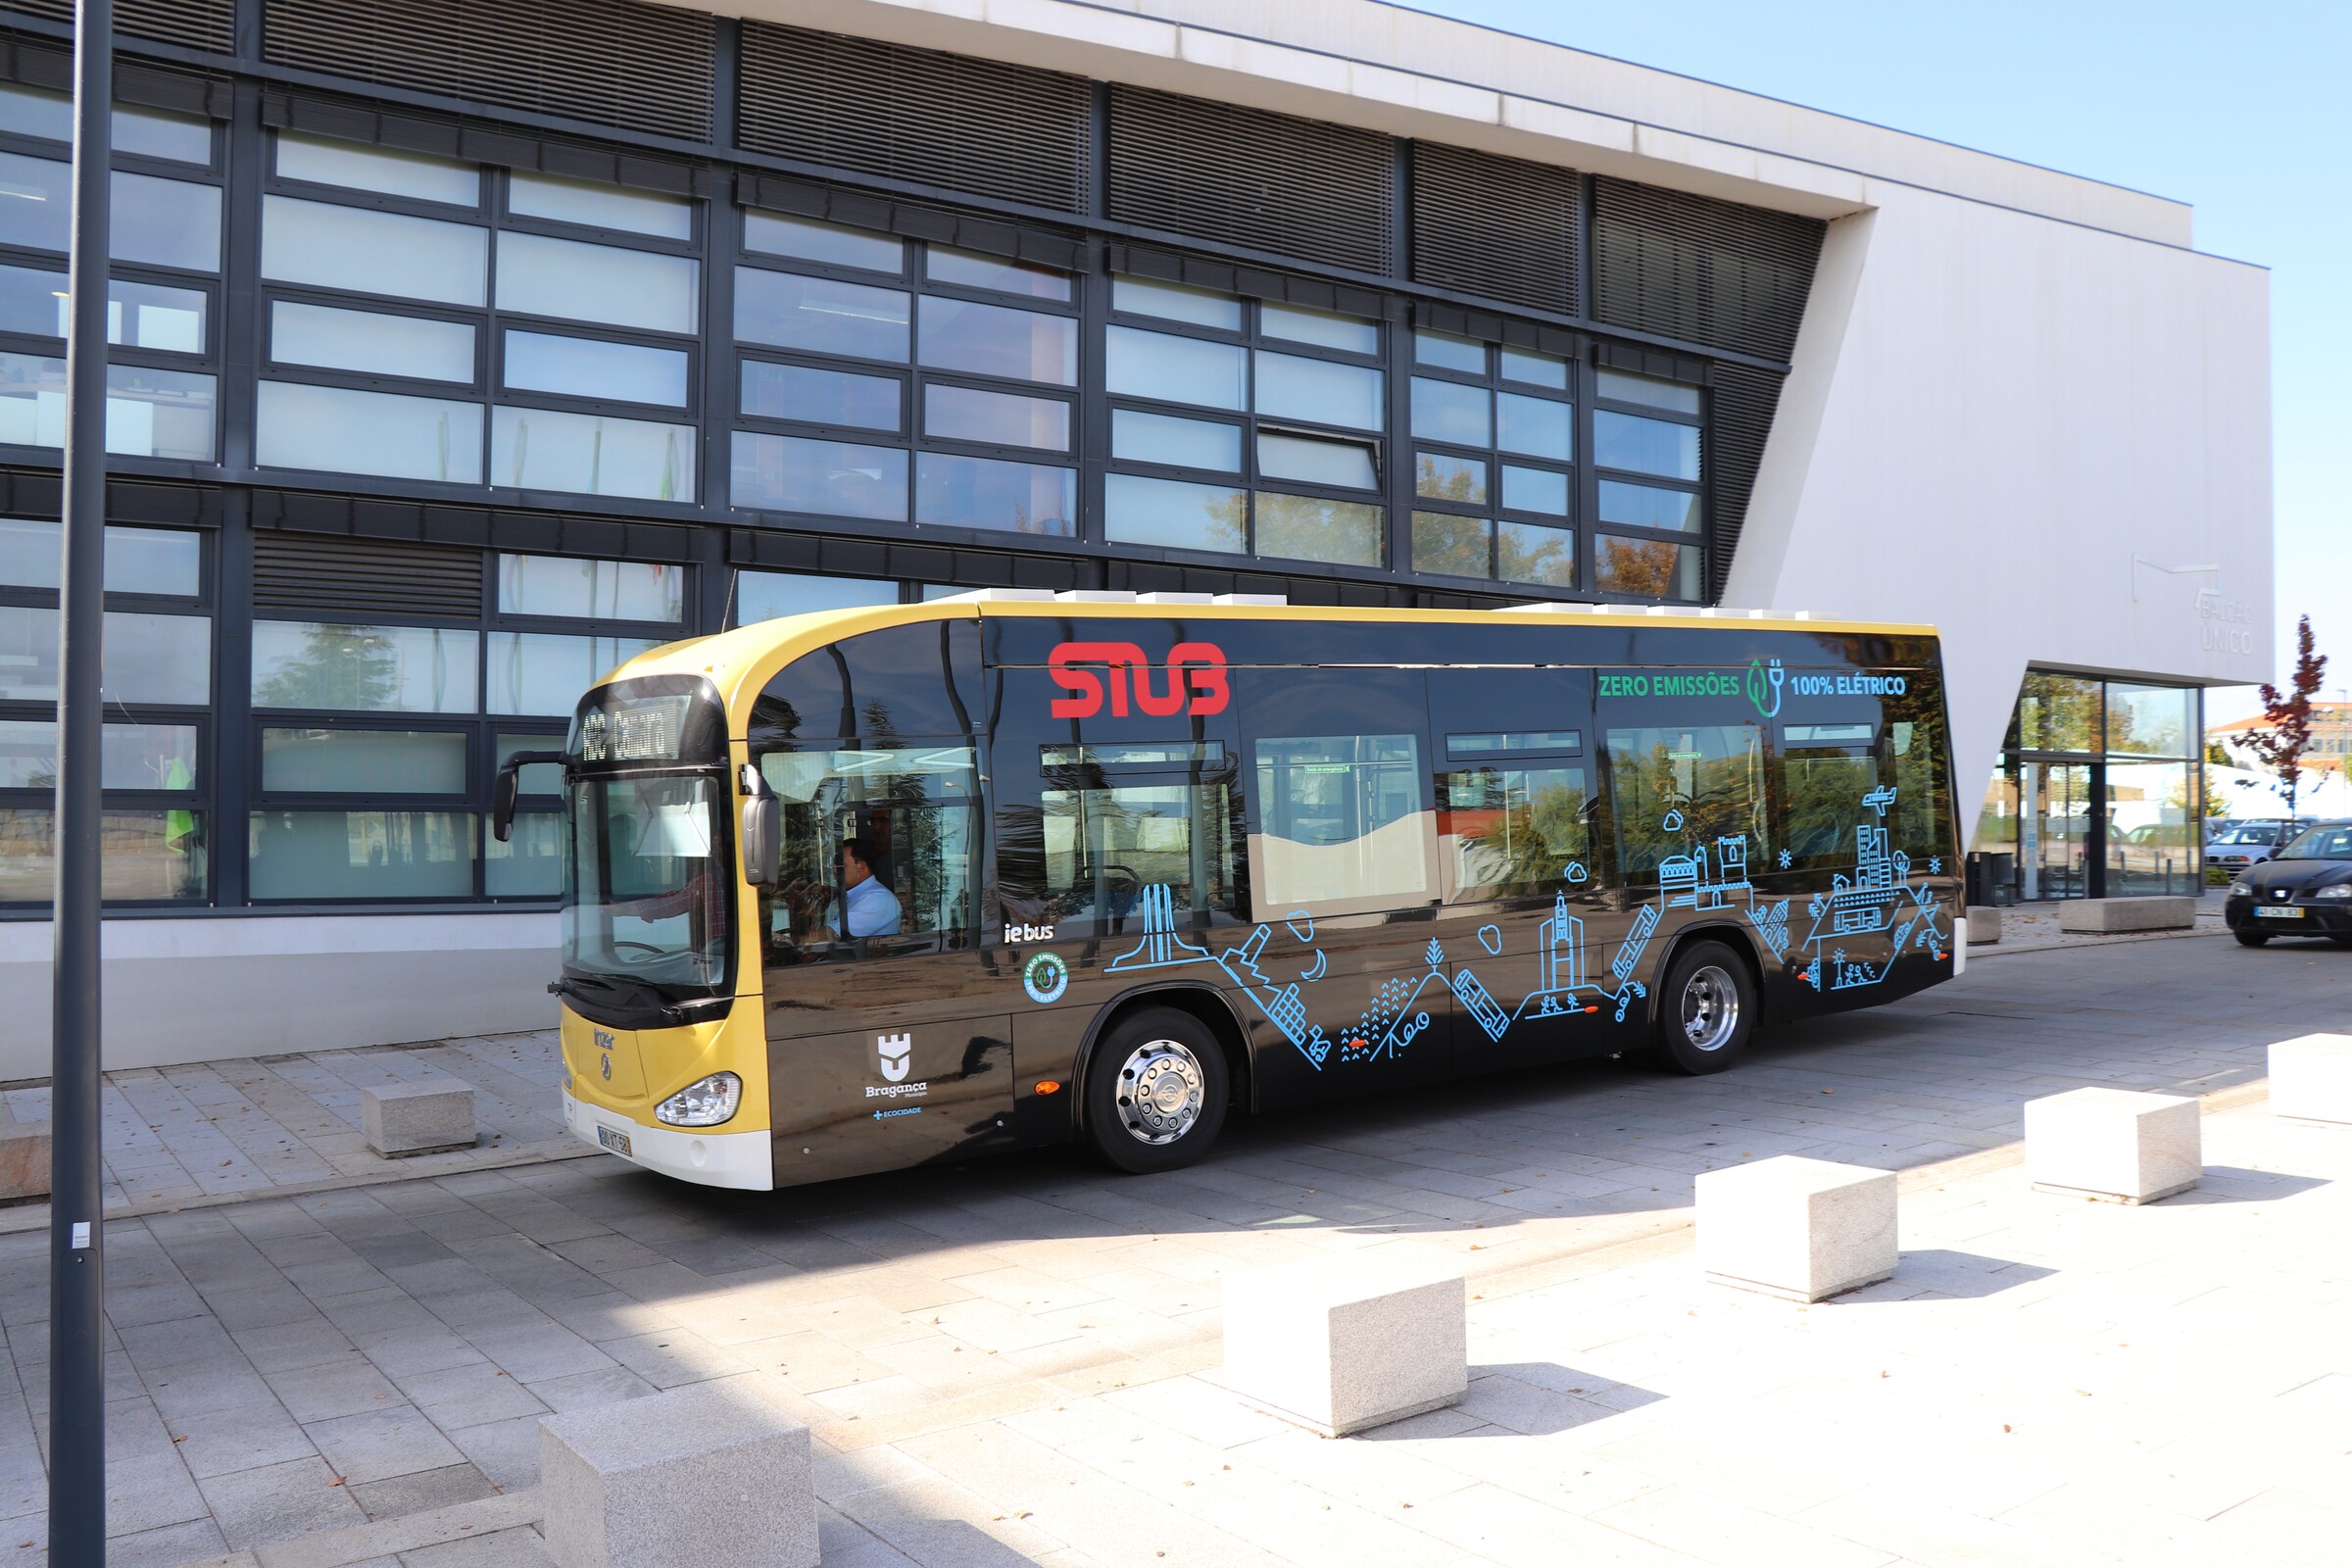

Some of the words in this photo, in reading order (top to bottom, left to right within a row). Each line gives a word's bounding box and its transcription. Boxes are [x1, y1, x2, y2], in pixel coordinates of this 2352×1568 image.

[2201, 618, 2253, 656] ÚNICO
[1048, 642, 1230, 718] STUB
[1598, 675, 1648, 696] ZERO
[1653, 671, 1740, 696] EMISSÕES
[1790, 675, 1835, 695] 100%
[1837, 671, 1906, 695] ELÉTRICO
[1026, 958, 1038, 977] ZERO
[1038, 954, 1066, 974] EMISSÕES
[1026, 981, 1040, 1000] 100%
[1040, 977, 1066, 1002] ELÉTRICO
[865, 1082, 927, 1098] Bragança
